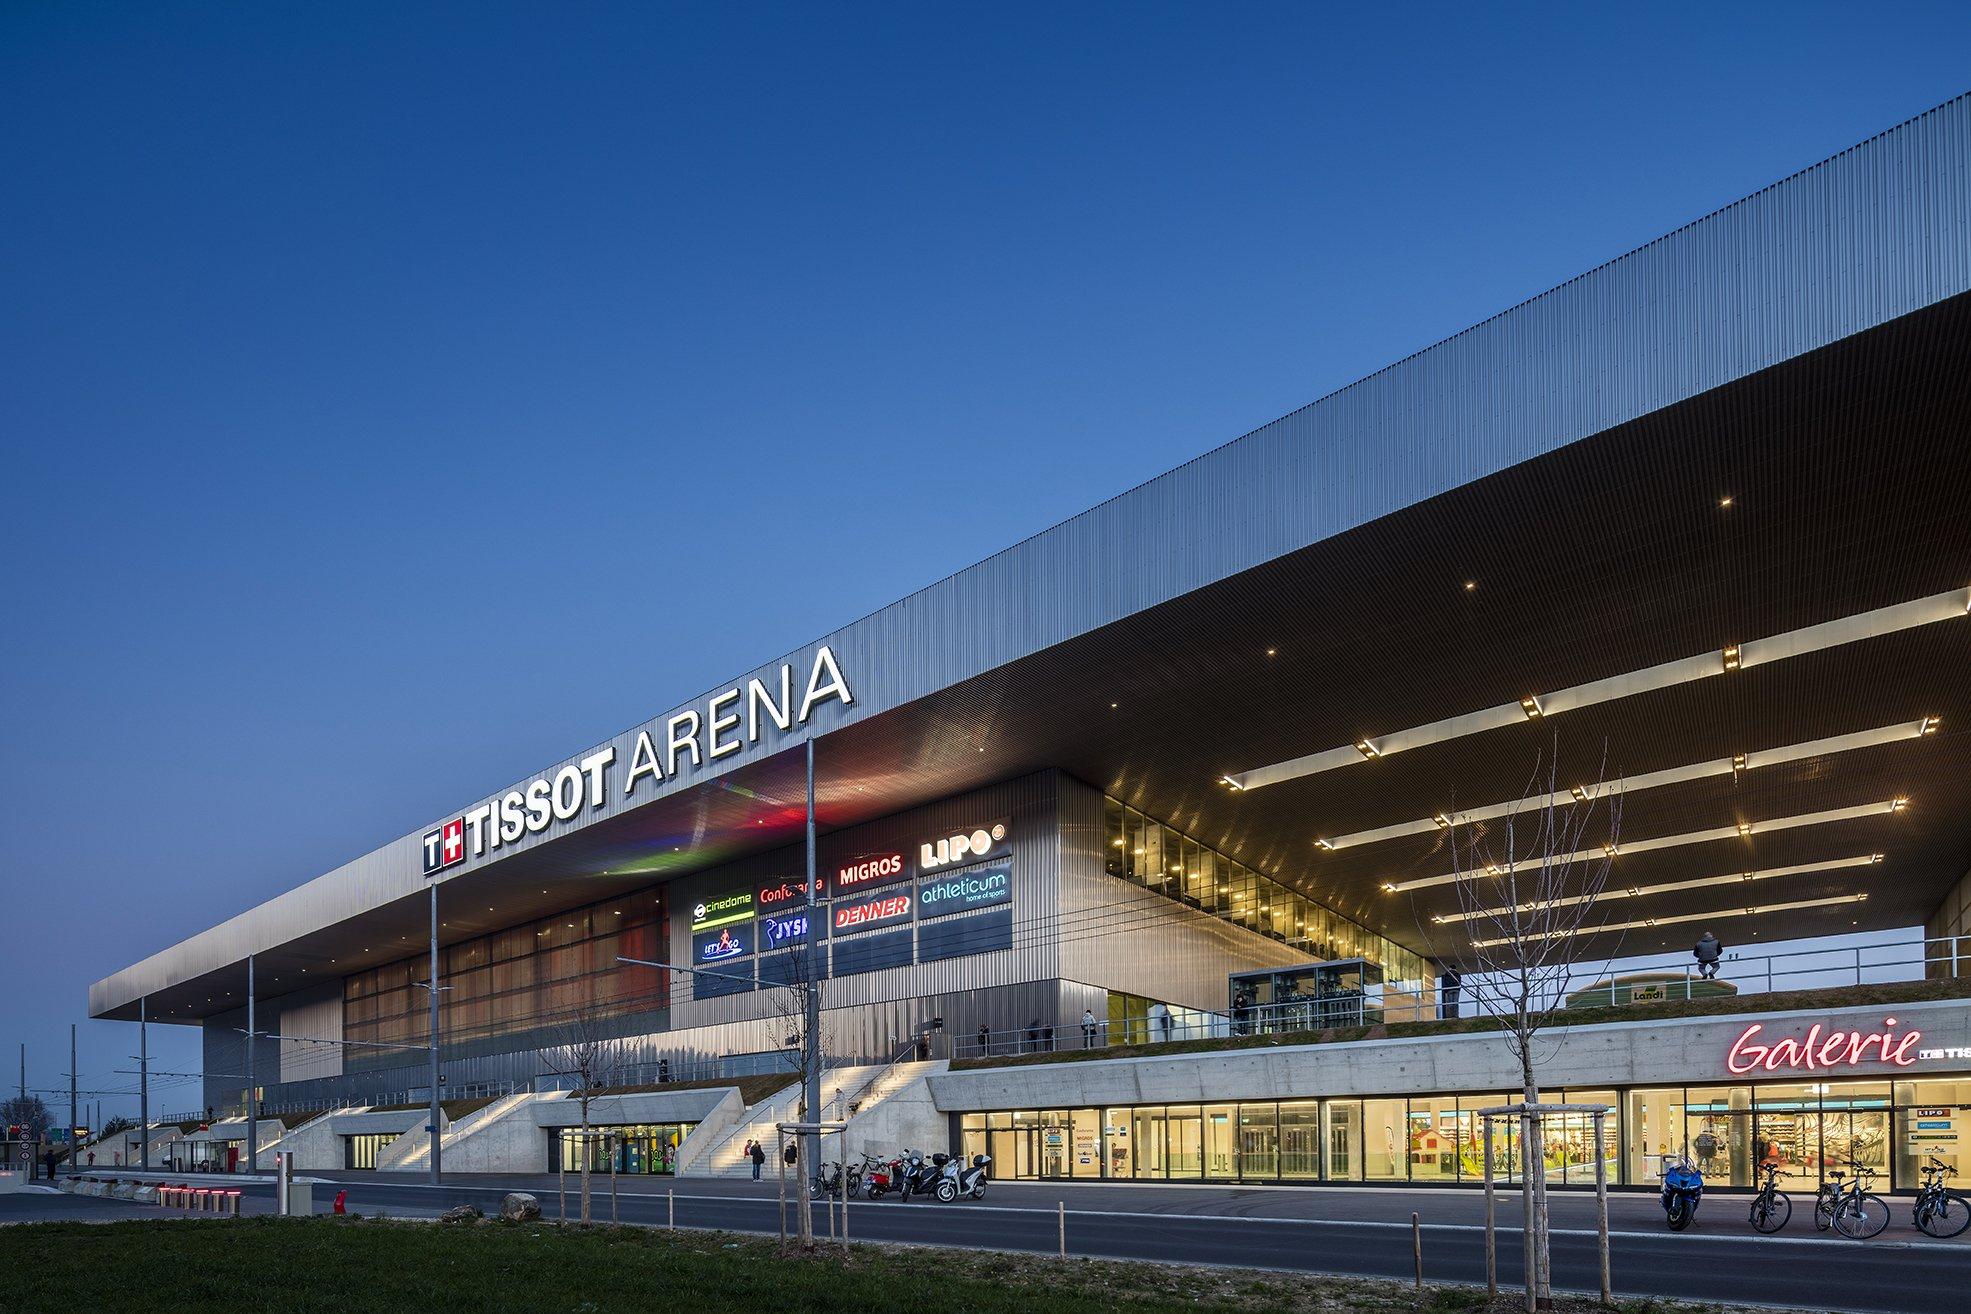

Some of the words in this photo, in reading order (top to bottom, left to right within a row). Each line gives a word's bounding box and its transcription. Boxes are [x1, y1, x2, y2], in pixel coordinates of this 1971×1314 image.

[466, 746, 616, 856] TISSOT
[625, 645, 854, 794] ARENA
[921, 829, 992, 868] LIPO
[840, 855, 902, 885] MIGROS
[706, 893, 752, 913] cinedome
[921, 874, 1006, 903] athleticum
[966, 893, 981, 902] home
[982, 891, 989, 899] of
[989, 888, 1006, 898] sports
[836, 896, 911, 927] DENNER
[729, 939, 739, 949] GO
[1633, 990, 1664, 1000] Landi
[1727, 1018, 1921, 1074] Galerie
